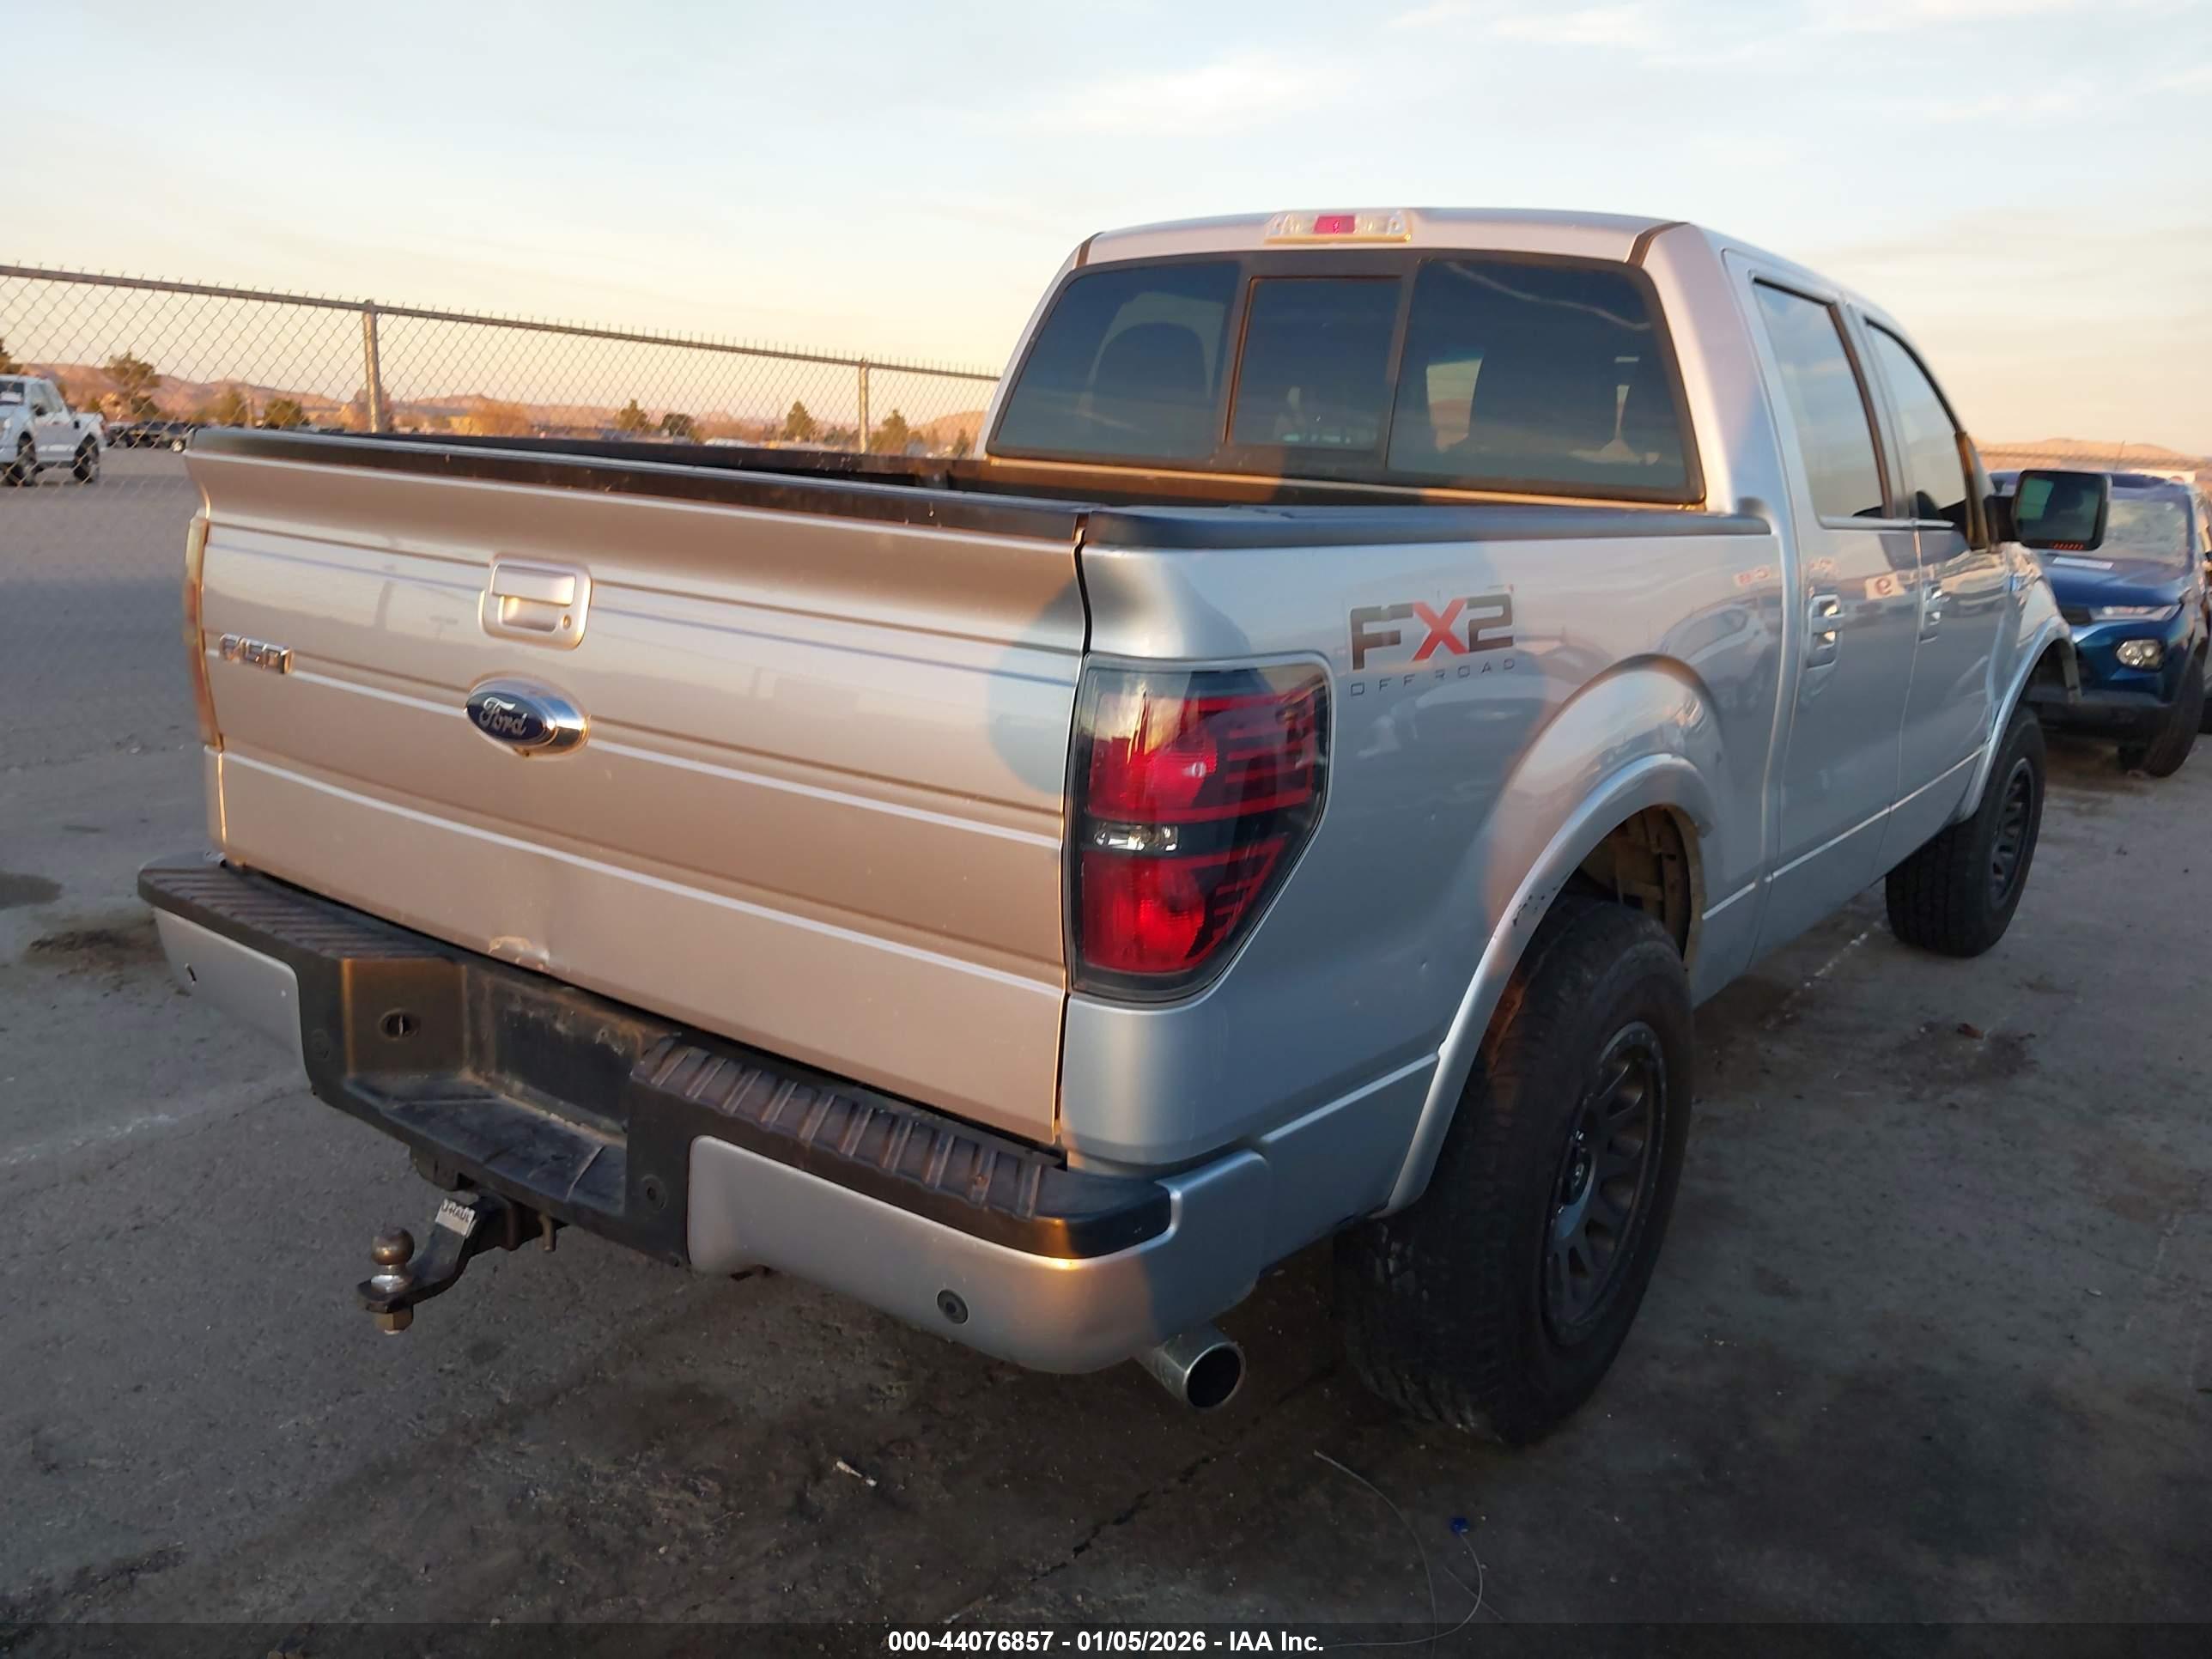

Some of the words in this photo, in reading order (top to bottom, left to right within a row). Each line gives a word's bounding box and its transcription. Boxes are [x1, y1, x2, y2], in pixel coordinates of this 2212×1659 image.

[1350, 593, 1514, 670] FX2
[1350, 674, 1415, 696] OFF
[1435, 658, 1516, 679] ROAD
[479, 696, 528, 736] Ford
